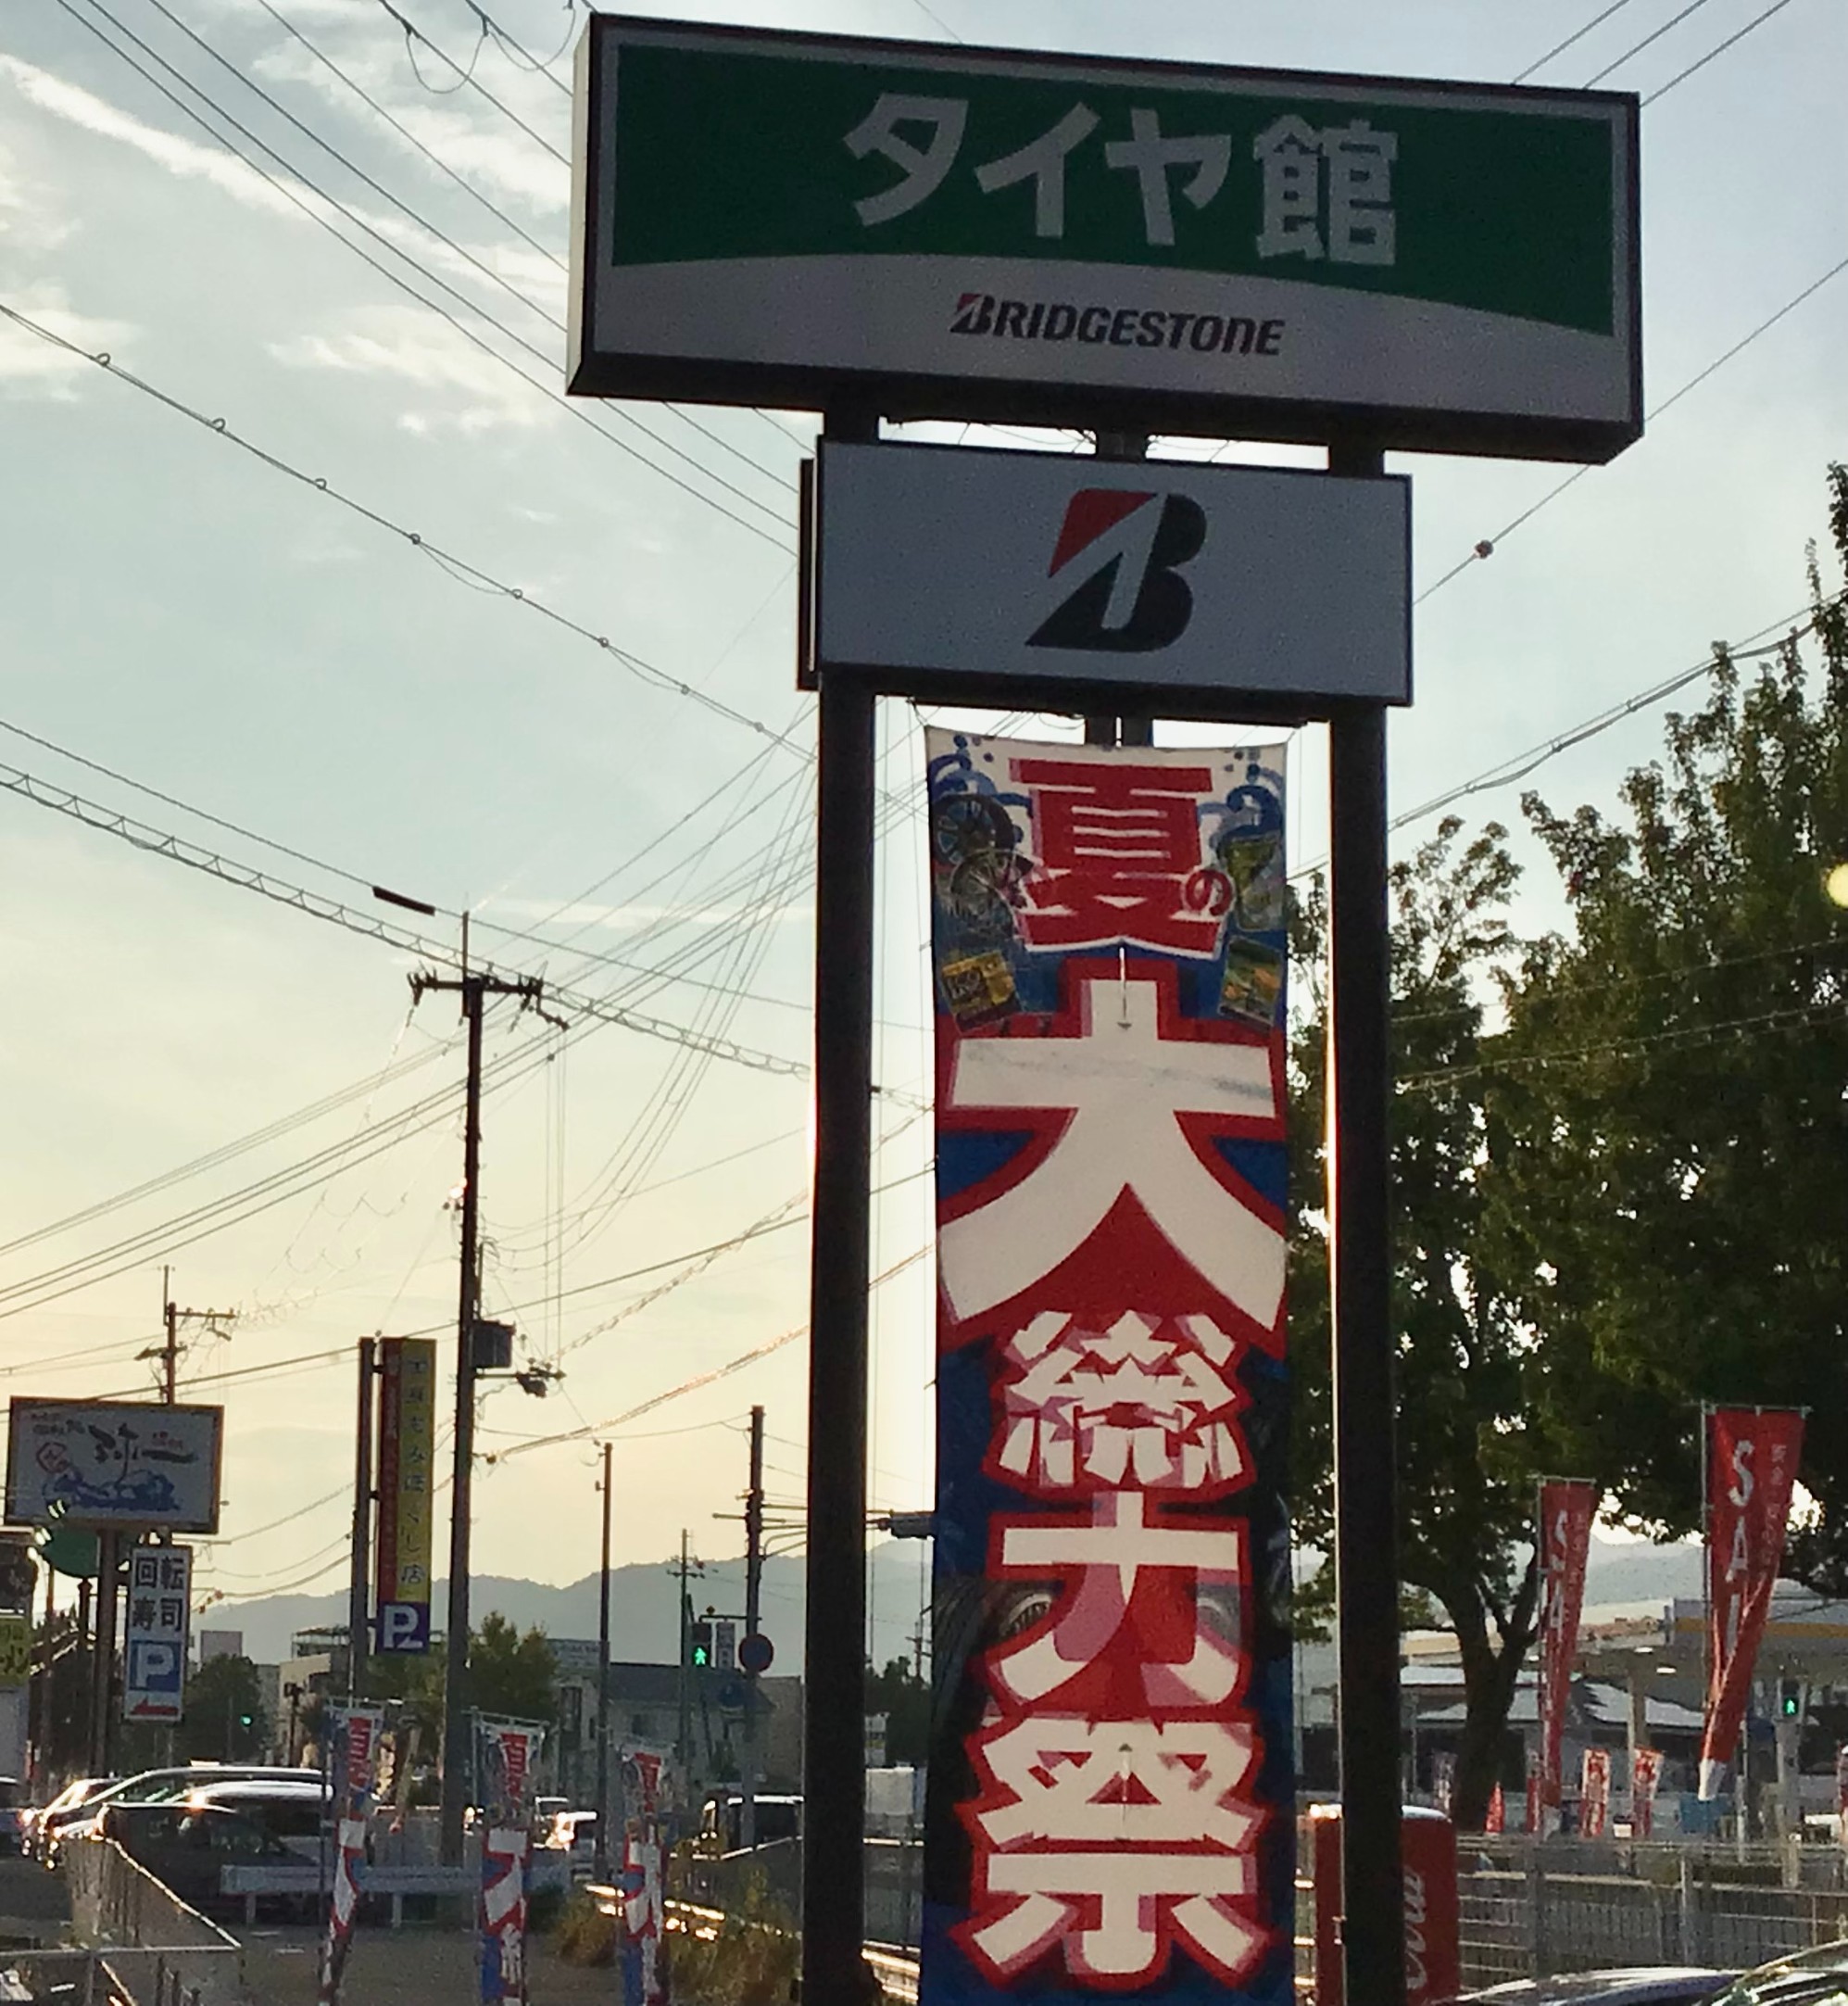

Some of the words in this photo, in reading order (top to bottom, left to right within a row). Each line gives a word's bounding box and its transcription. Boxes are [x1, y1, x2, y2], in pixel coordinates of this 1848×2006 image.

[843, 93, 1400, 266] タイヤ館
[949, 293, 1286, 356] BRIDGESTONE
[135, 1556, 184, 1590] 回転
[132, 1597, 183, 1632] 寿司
[135, 1644, 175, 1688] P
